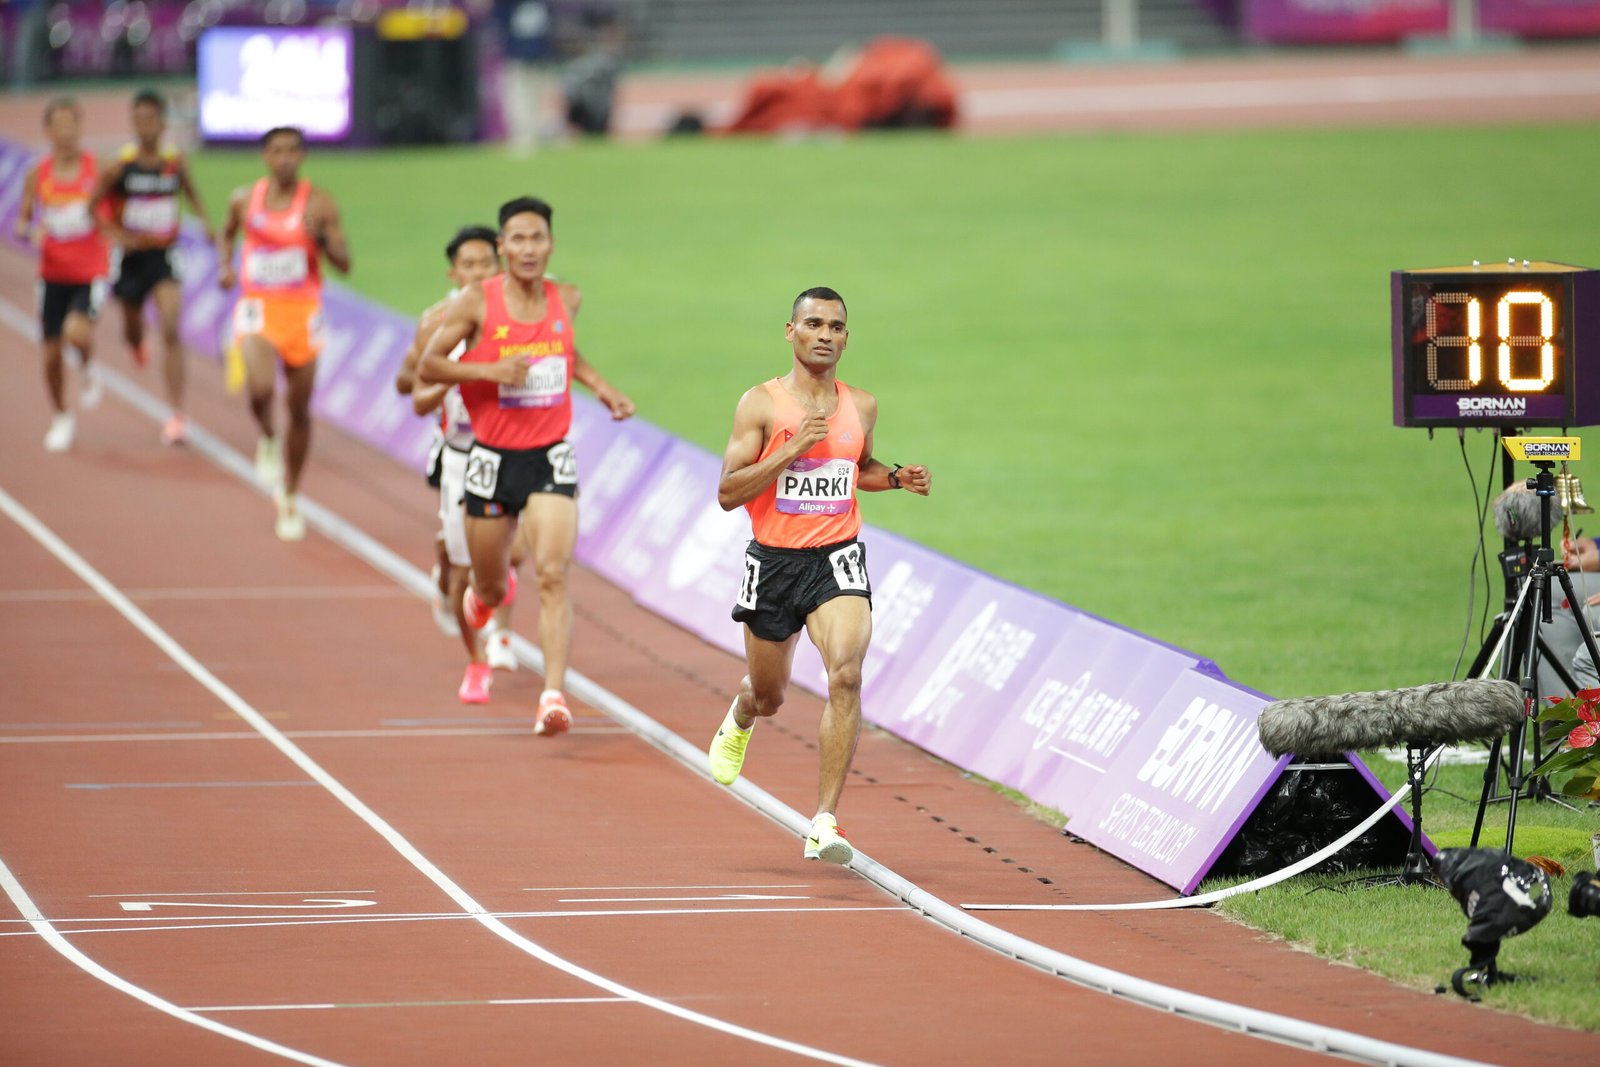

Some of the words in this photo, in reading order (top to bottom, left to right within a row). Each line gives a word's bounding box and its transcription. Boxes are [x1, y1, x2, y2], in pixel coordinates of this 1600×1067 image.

[1467, 291, 1554, 391] 10
[1456, 397, 1526, 410] BORNAN
[1523, 443, 1570, 452] BORNAN
[469, 456, 494, 489] 20
[784, 475, 848, 497] PARKI
[838, 467, 850, 476] 624
[837, 549, 865, 584] 11
[1136, 696, 1263, 815] BORNAN
[1098, 792, 1150, 841] SPORTS
[1128, 806, 1201, 866] TECHNOLOGY
